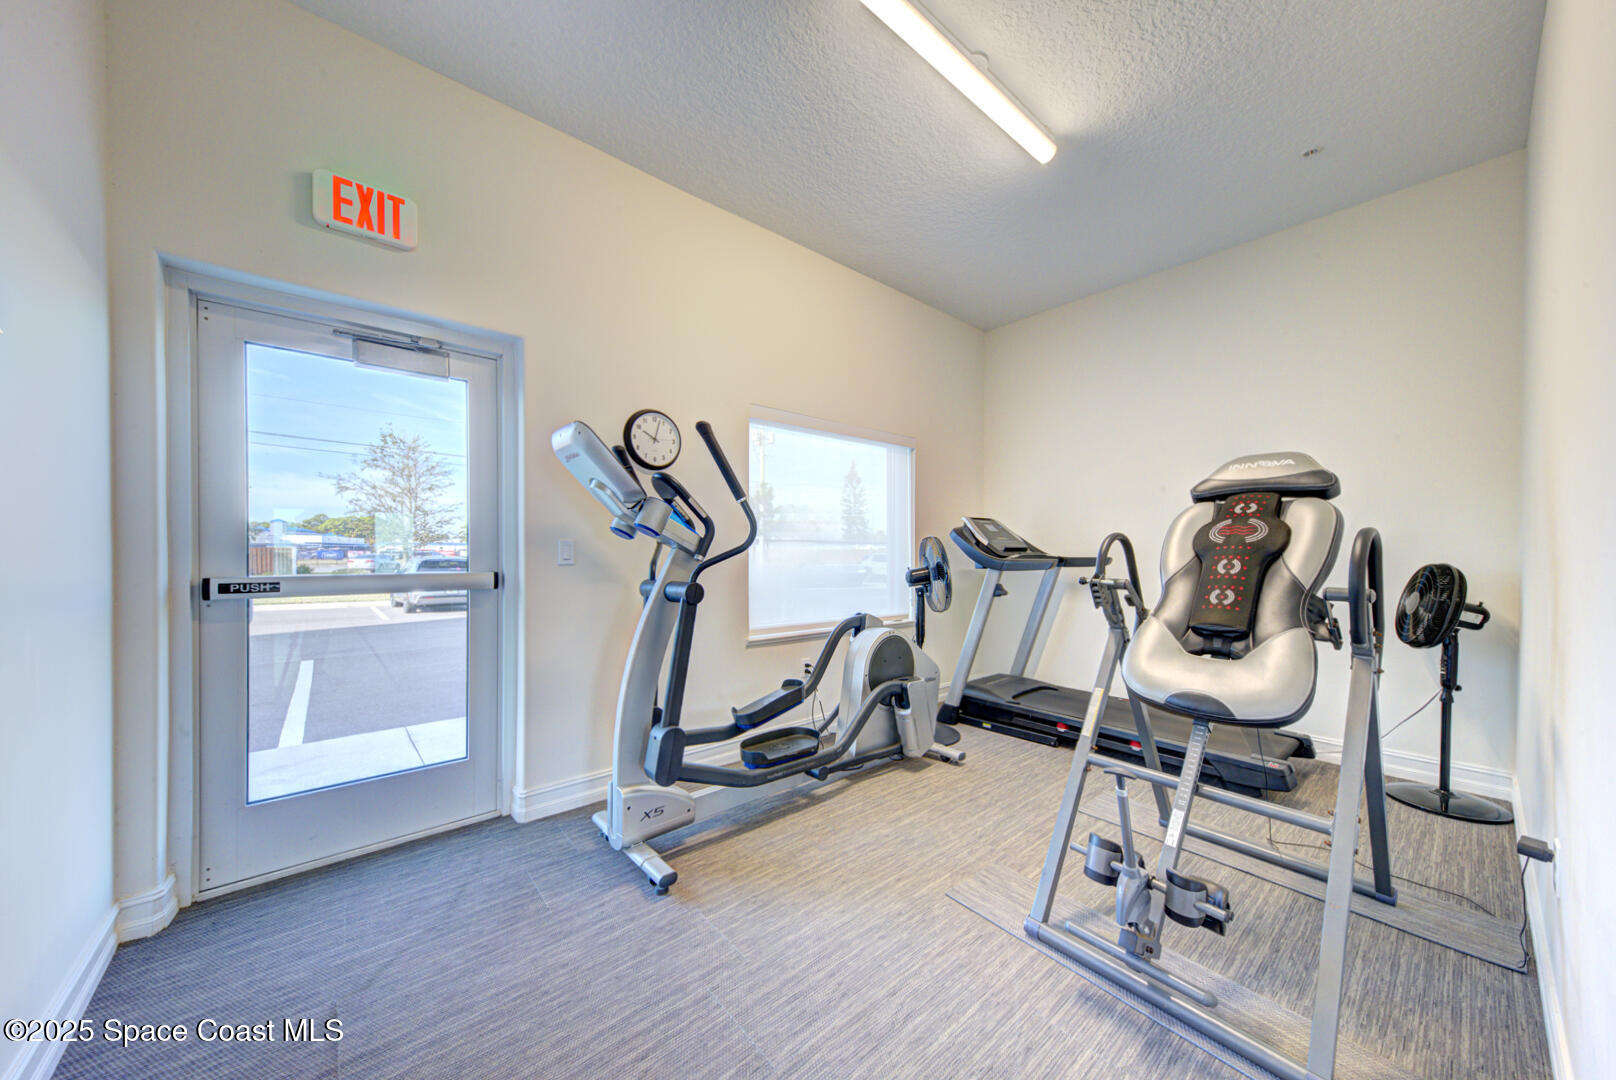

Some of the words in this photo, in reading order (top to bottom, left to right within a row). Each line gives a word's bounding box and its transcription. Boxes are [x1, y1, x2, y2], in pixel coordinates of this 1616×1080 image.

[332, 174, 406, 240] EXIT
[1229, 459, 1295, 470] INNOVA
[230, 583, 270, 592] PUSH
[640, 806, 665, 821] X5
